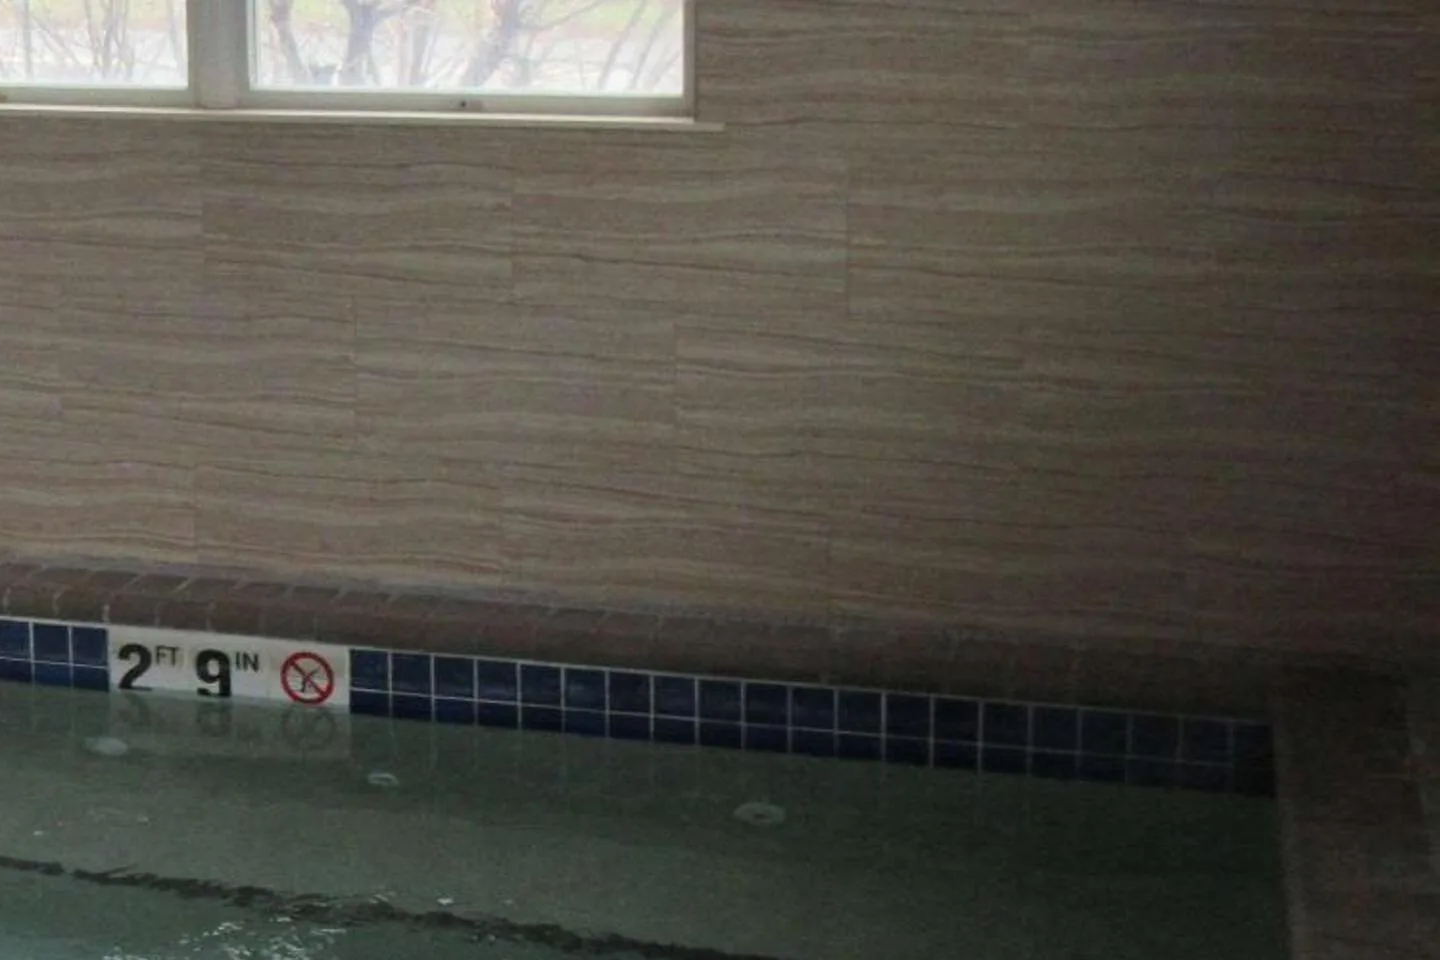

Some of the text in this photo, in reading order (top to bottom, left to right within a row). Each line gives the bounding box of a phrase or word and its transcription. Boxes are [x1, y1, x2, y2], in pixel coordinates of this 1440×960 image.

[117, 643, 259, 697] 2 FT 9 IN
